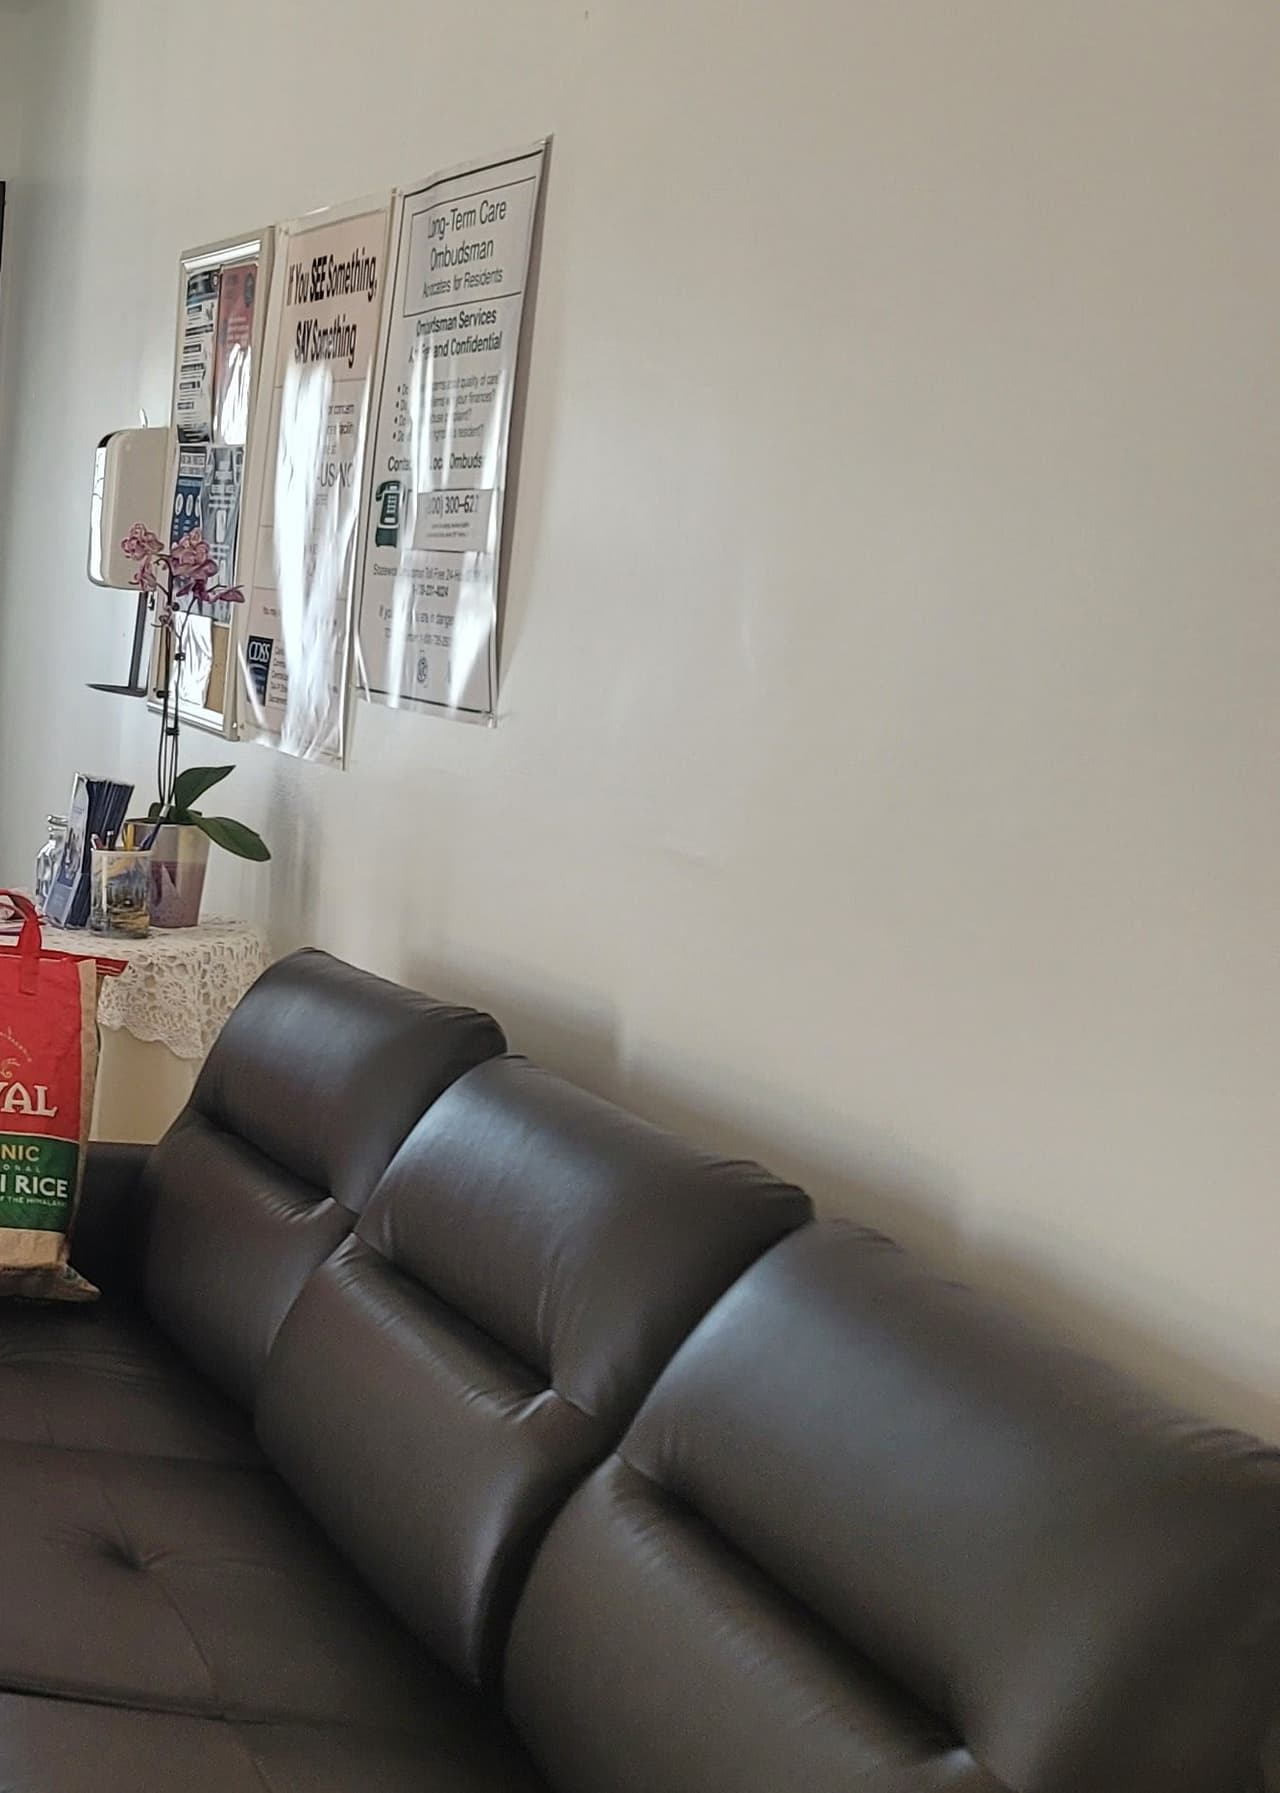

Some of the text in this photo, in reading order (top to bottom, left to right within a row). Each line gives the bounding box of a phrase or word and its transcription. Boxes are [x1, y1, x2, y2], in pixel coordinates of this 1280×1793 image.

[479, 199, 507, 225] Care
[430, 239, 494, 271] Ombudsman
[295, 263, 310, 305] You
[310, 255, 327, 303] SEE
[327, 246, 378, 303] Something,
[463, 267, 504, 289] Residents
[458, 308, 497, 329] Services
[294, 319, 312, 364] SAY
[311, 313, 357, 369] Something
[433, 339, 450, 358] and
[450, 330, 503, 357] Confidential
[15, 1174, 69, 1199] RICE
[8, 1196, 24, 1204] THE
